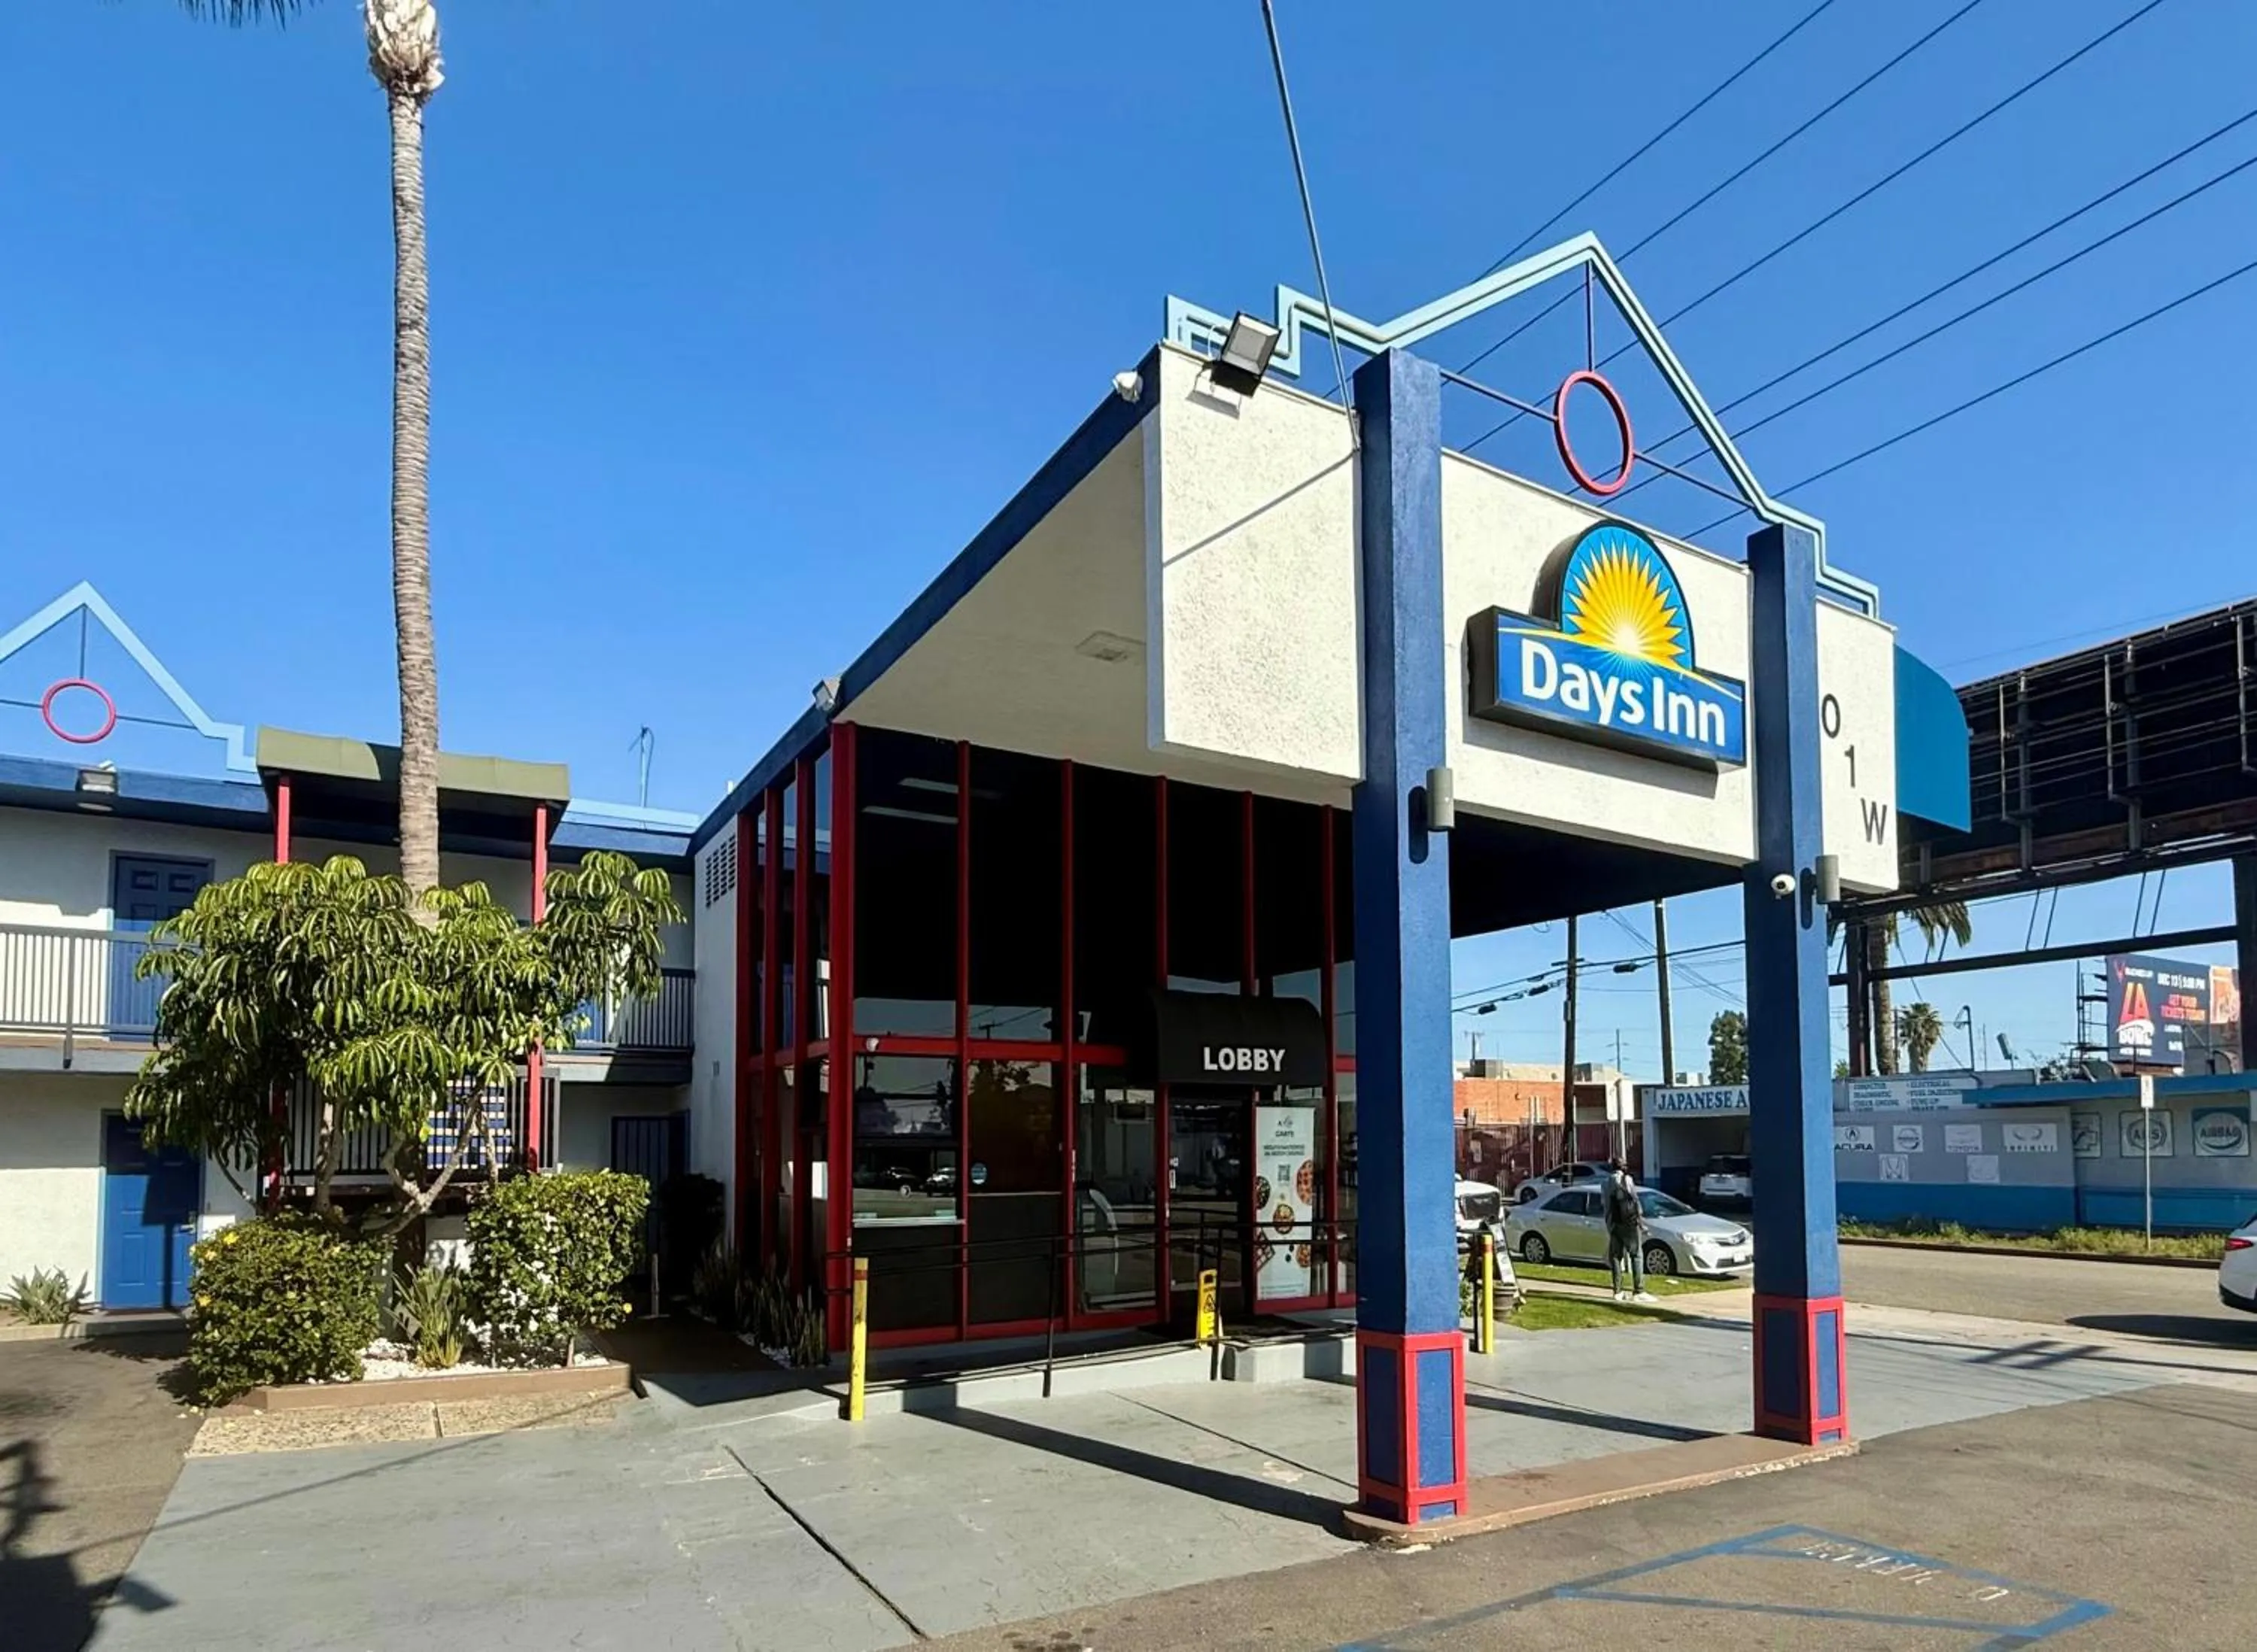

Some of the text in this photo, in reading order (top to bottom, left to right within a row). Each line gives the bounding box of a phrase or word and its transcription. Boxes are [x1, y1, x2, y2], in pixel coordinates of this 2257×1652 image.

[1520, 638, 1726, 746] Days Inn
[1204, 1047, 1286, 1071] LOBBY
[1658, 1092, 1733, 1110] JAPANESE
[1834, 1143, 1873, 1151] ACURA
